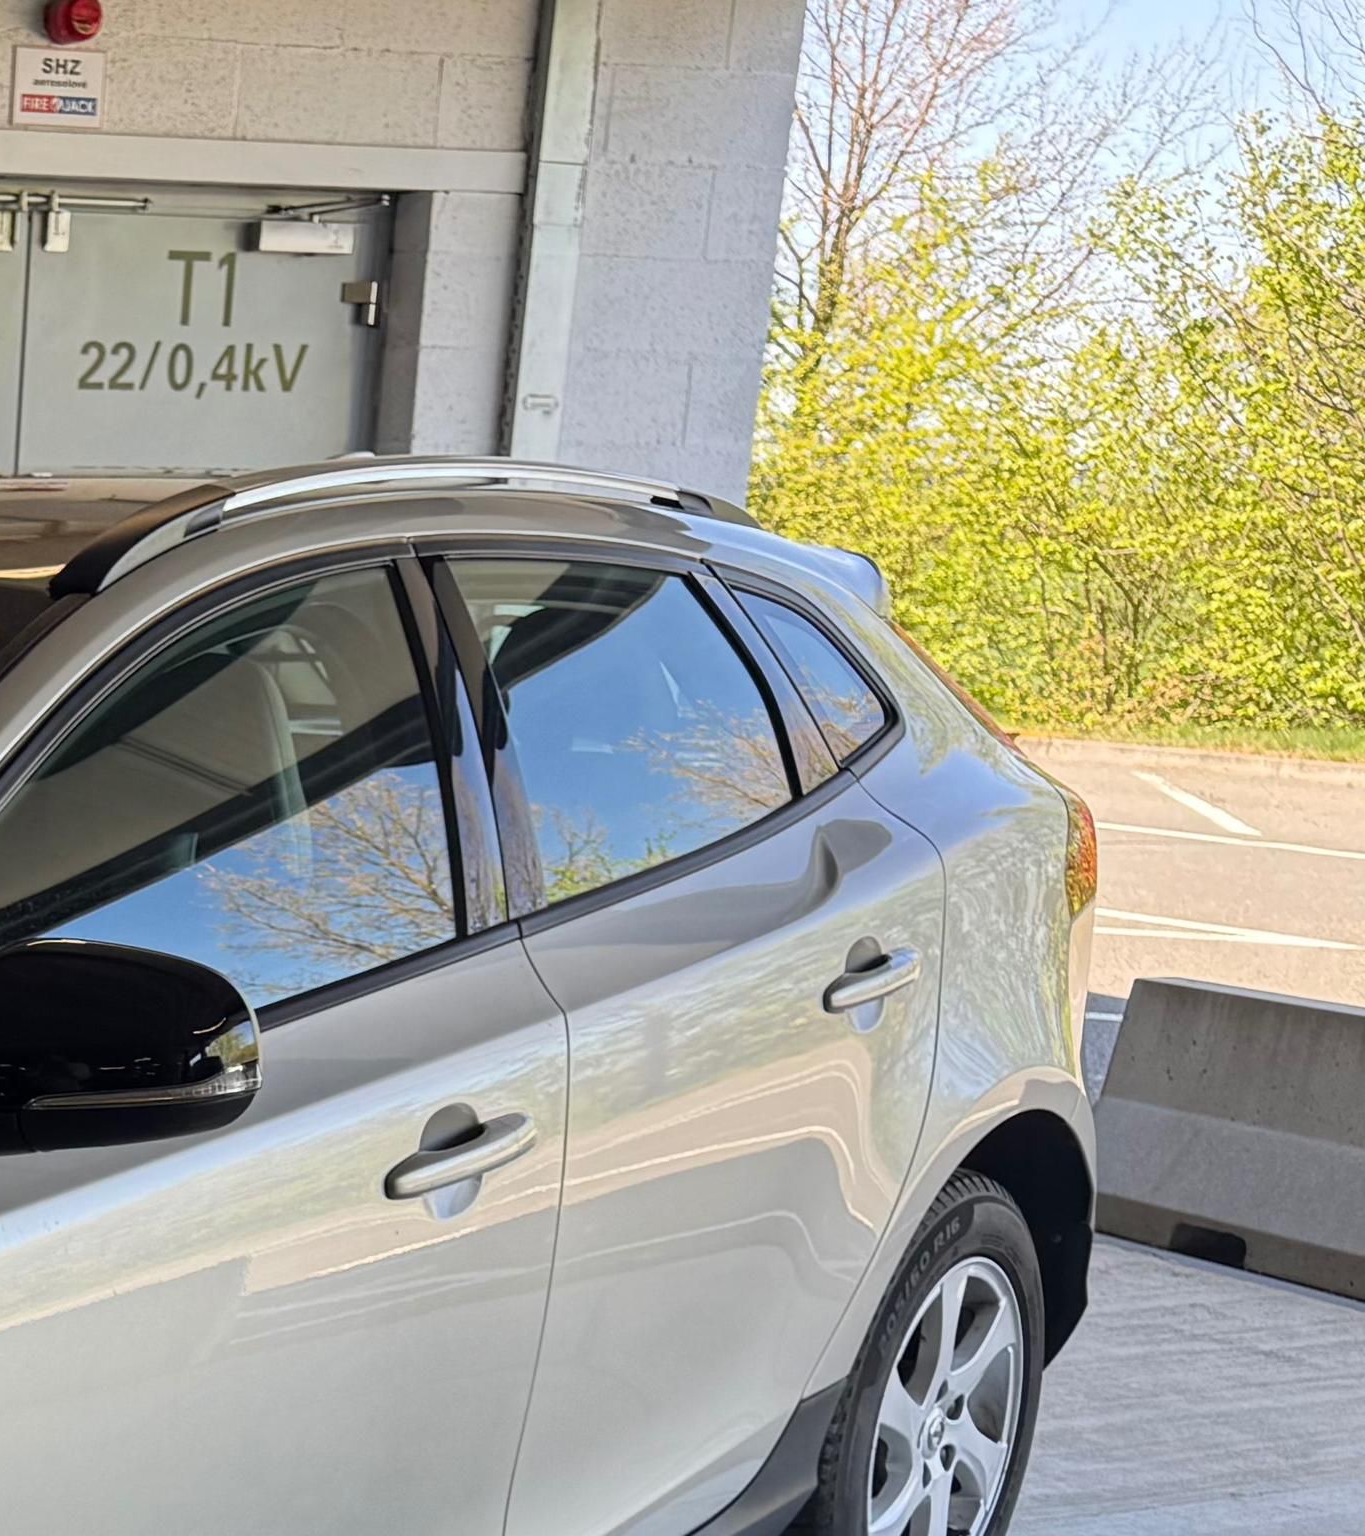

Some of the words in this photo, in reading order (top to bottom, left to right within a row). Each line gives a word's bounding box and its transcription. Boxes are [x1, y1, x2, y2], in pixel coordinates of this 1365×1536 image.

[41, 57, 82, 75] SHZ
[168, 250, 237, 327] T1
[77, 340, 309, 399] 22/0,4kV
[933, 1216, 961, 1252] R16
